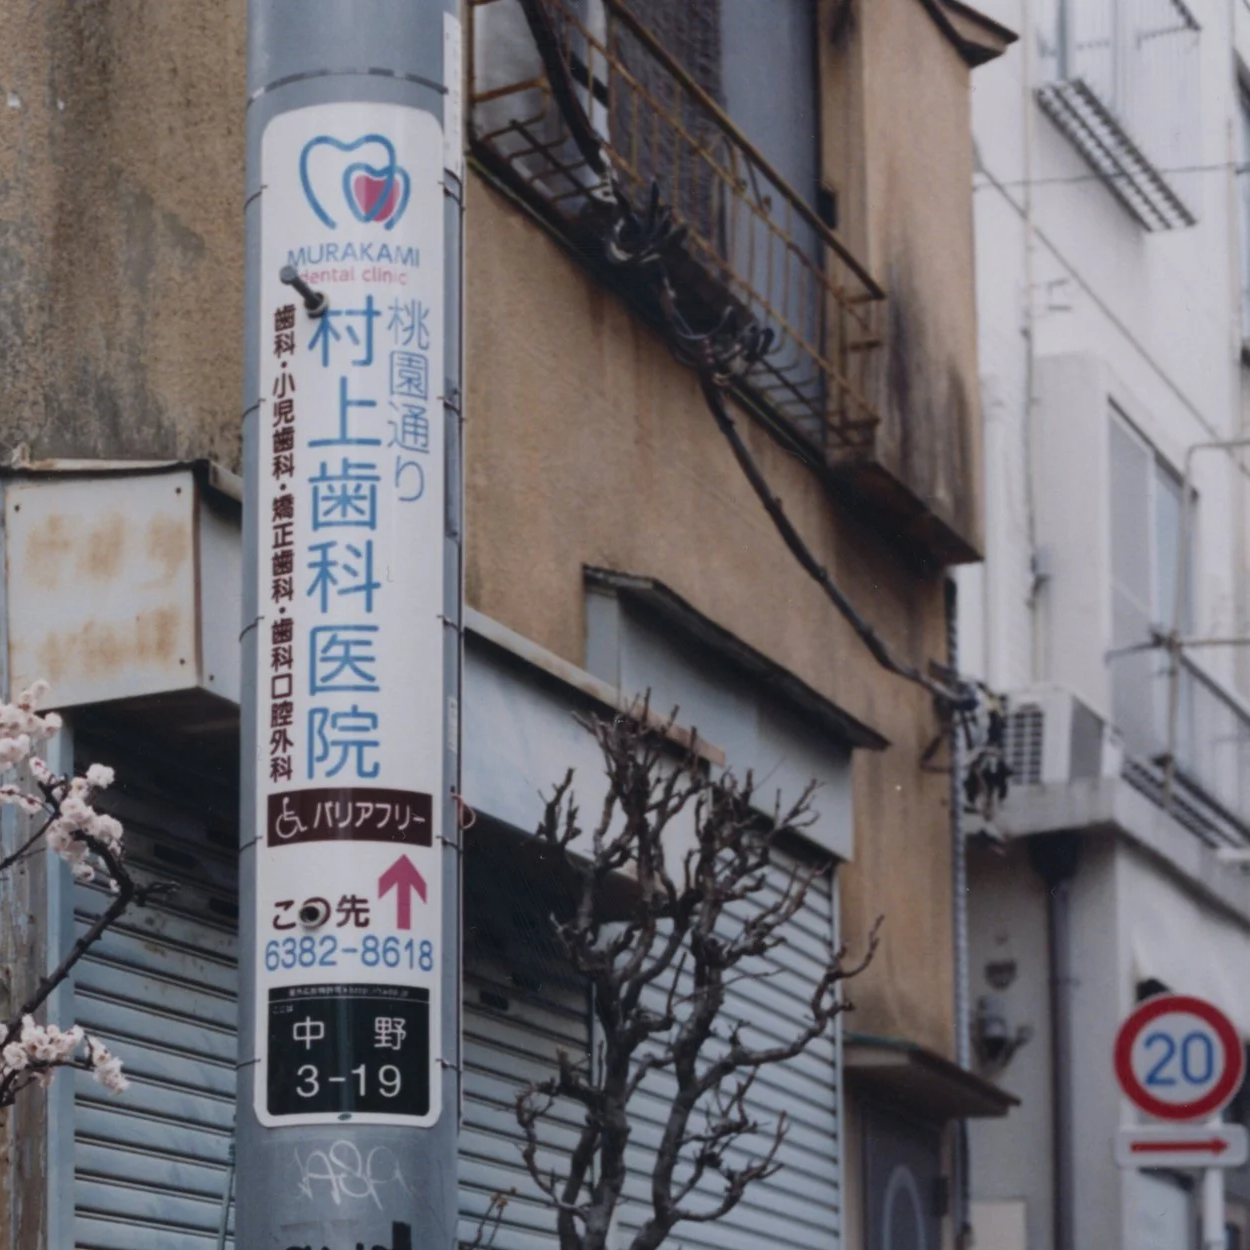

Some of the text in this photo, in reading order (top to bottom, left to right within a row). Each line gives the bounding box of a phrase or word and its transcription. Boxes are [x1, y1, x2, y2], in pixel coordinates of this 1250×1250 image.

[287, 242, 420, 268] MURAKAMI
[300, 266, 407, 285] dental clinic
[386, 297, 430, 502] 桃園通り
[306, 294, 382, 780] 村上歯科医院
[312, 801, 426, 830] バリアフリー
[265, 935, 434, 972] 6382-8618
[1144, 1030, 1214, 1086] 20
[296, 1064, 402, 1098] 3-19
